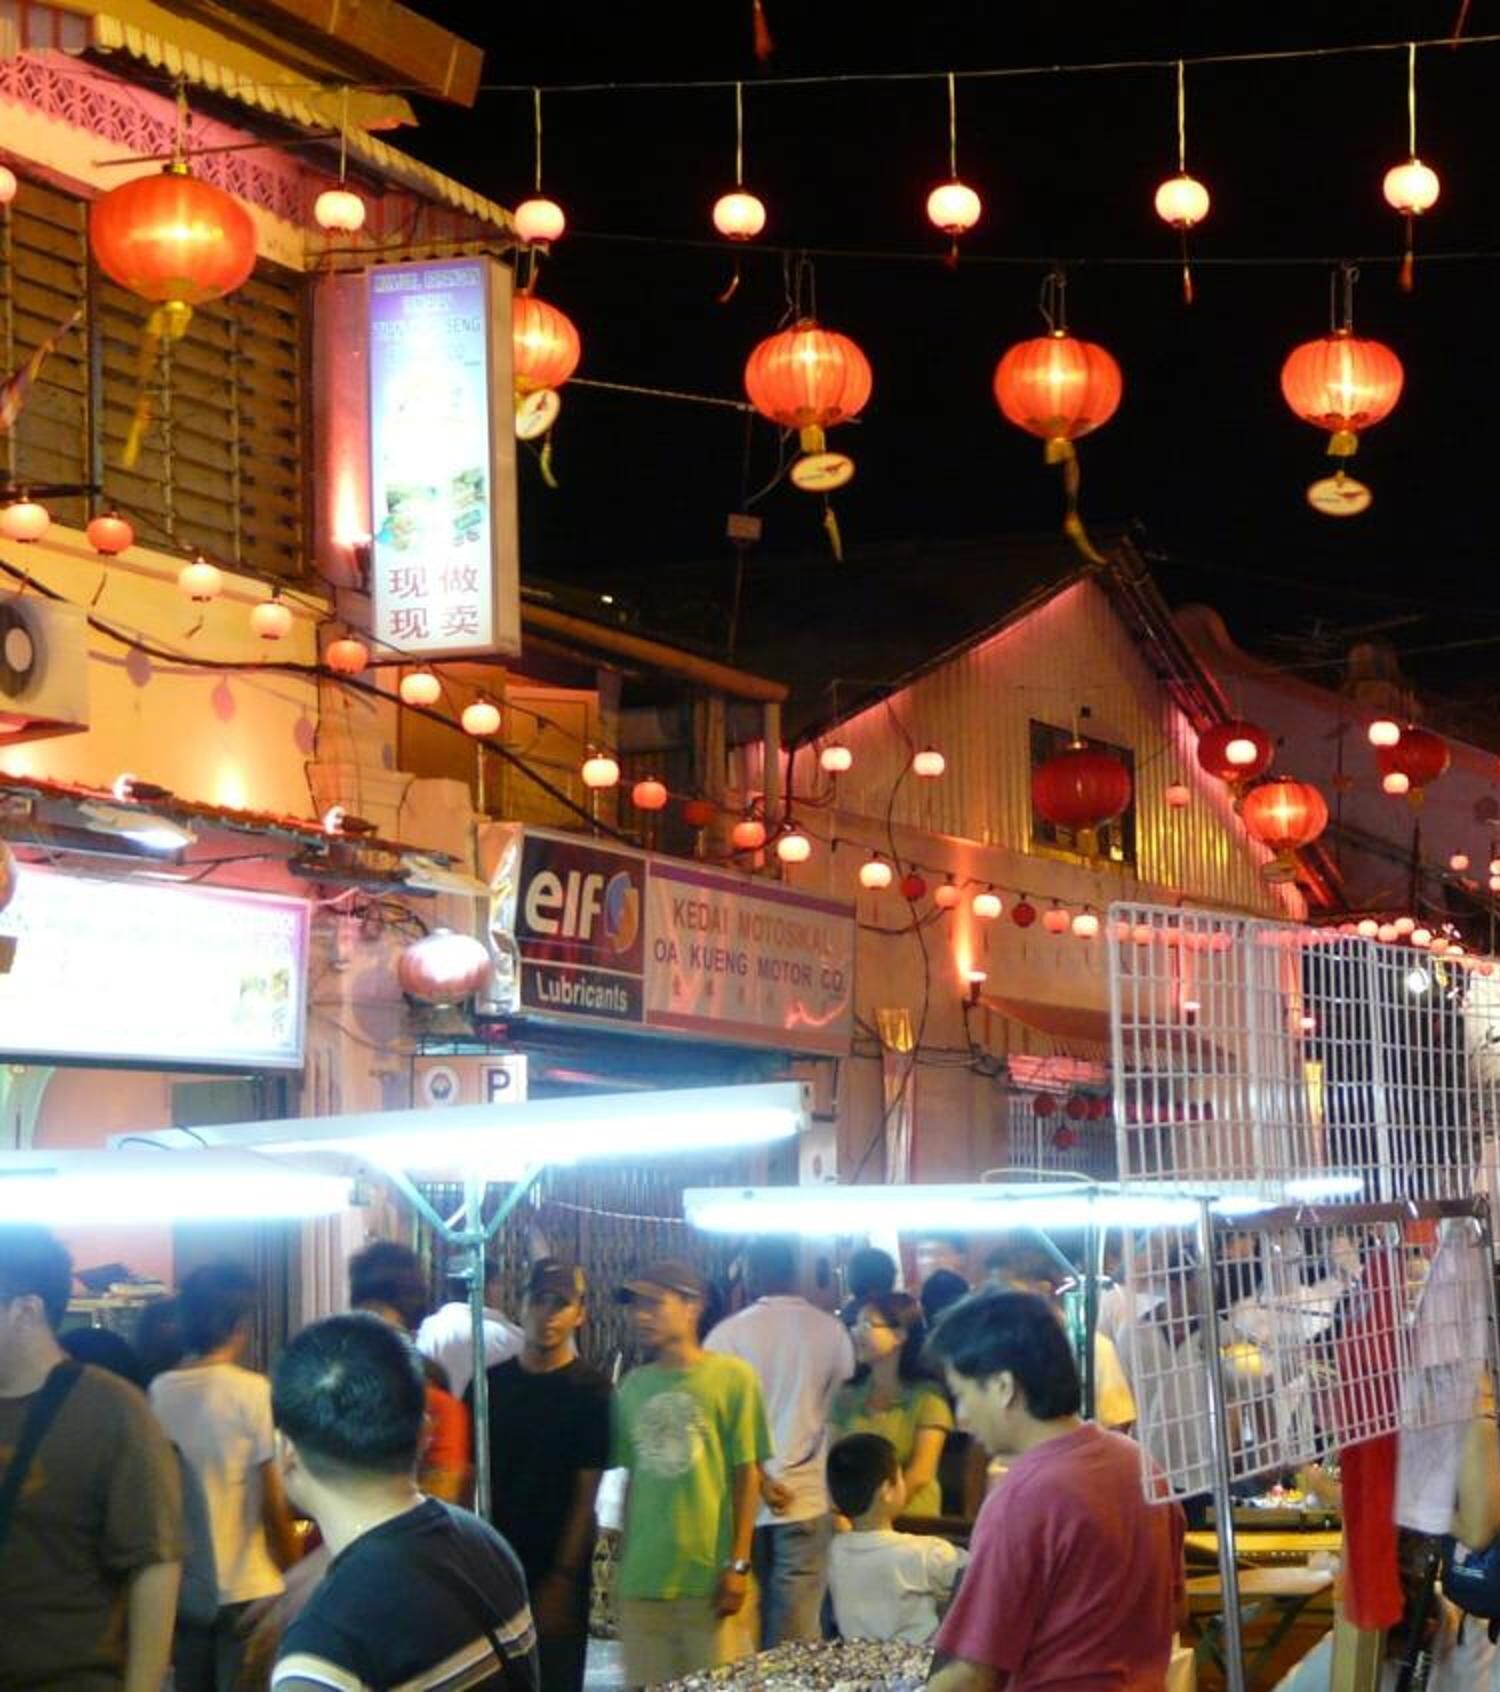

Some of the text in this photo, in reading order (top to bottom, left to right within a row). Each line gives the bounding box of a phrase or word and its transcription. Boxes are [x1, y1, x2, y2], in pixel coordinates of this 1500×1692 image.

[387, 564, 479, 600] 现做
[389, 604, 481, 640] 现卖
[525, 869, 604, 940] elf
[672, 898, 730, 936] KEDAI
[688, 942, 749, 977] KUENG
[757, 956, 813, 986] MOTOR
[536, 969, 629, 1015] Lubricants
